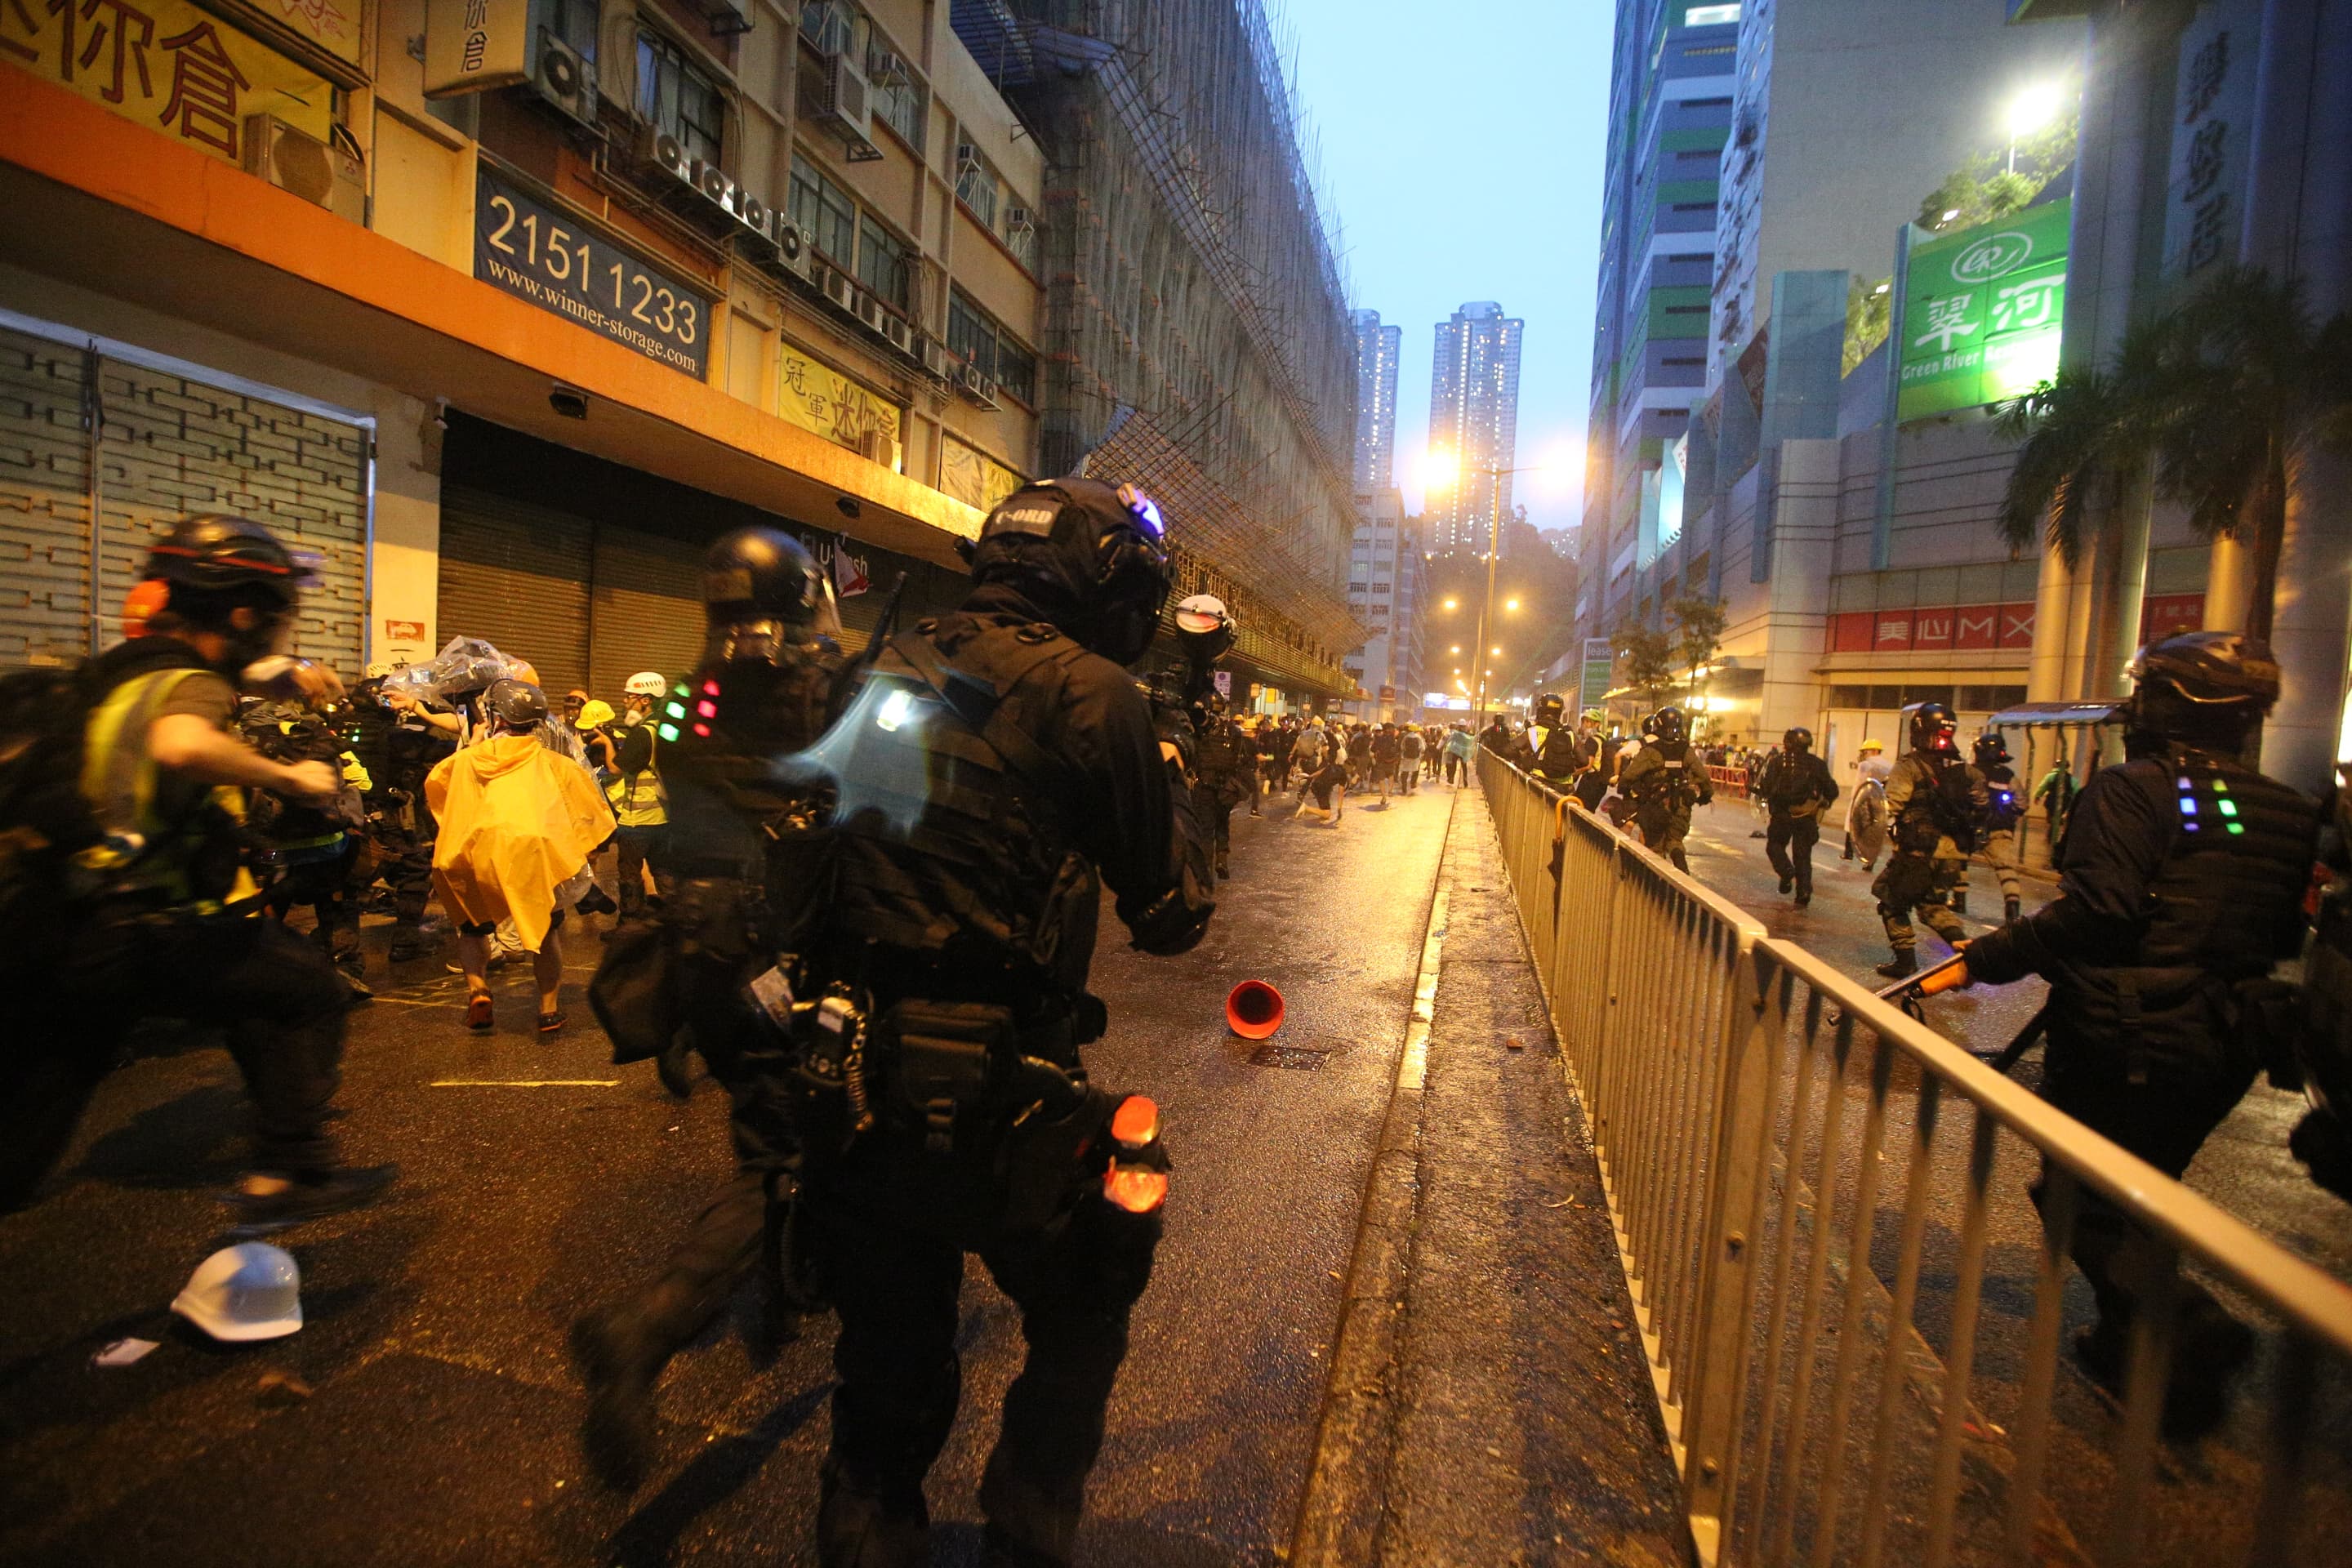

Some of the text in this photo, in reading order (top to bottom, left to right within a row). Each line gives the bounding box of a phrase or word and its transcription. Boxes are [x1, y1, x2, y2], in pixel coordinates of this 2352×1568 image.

[0, 0, 251, 159] 你倉
[488, 258, 698, 372] www.winner-storage.com
[489, 195, 697, 345] 2151 1233
[1914, 273, 2066, 352] 翠河
[1901, 359, 1940, 381] Green
[1942, 351, 1980, 372] River
